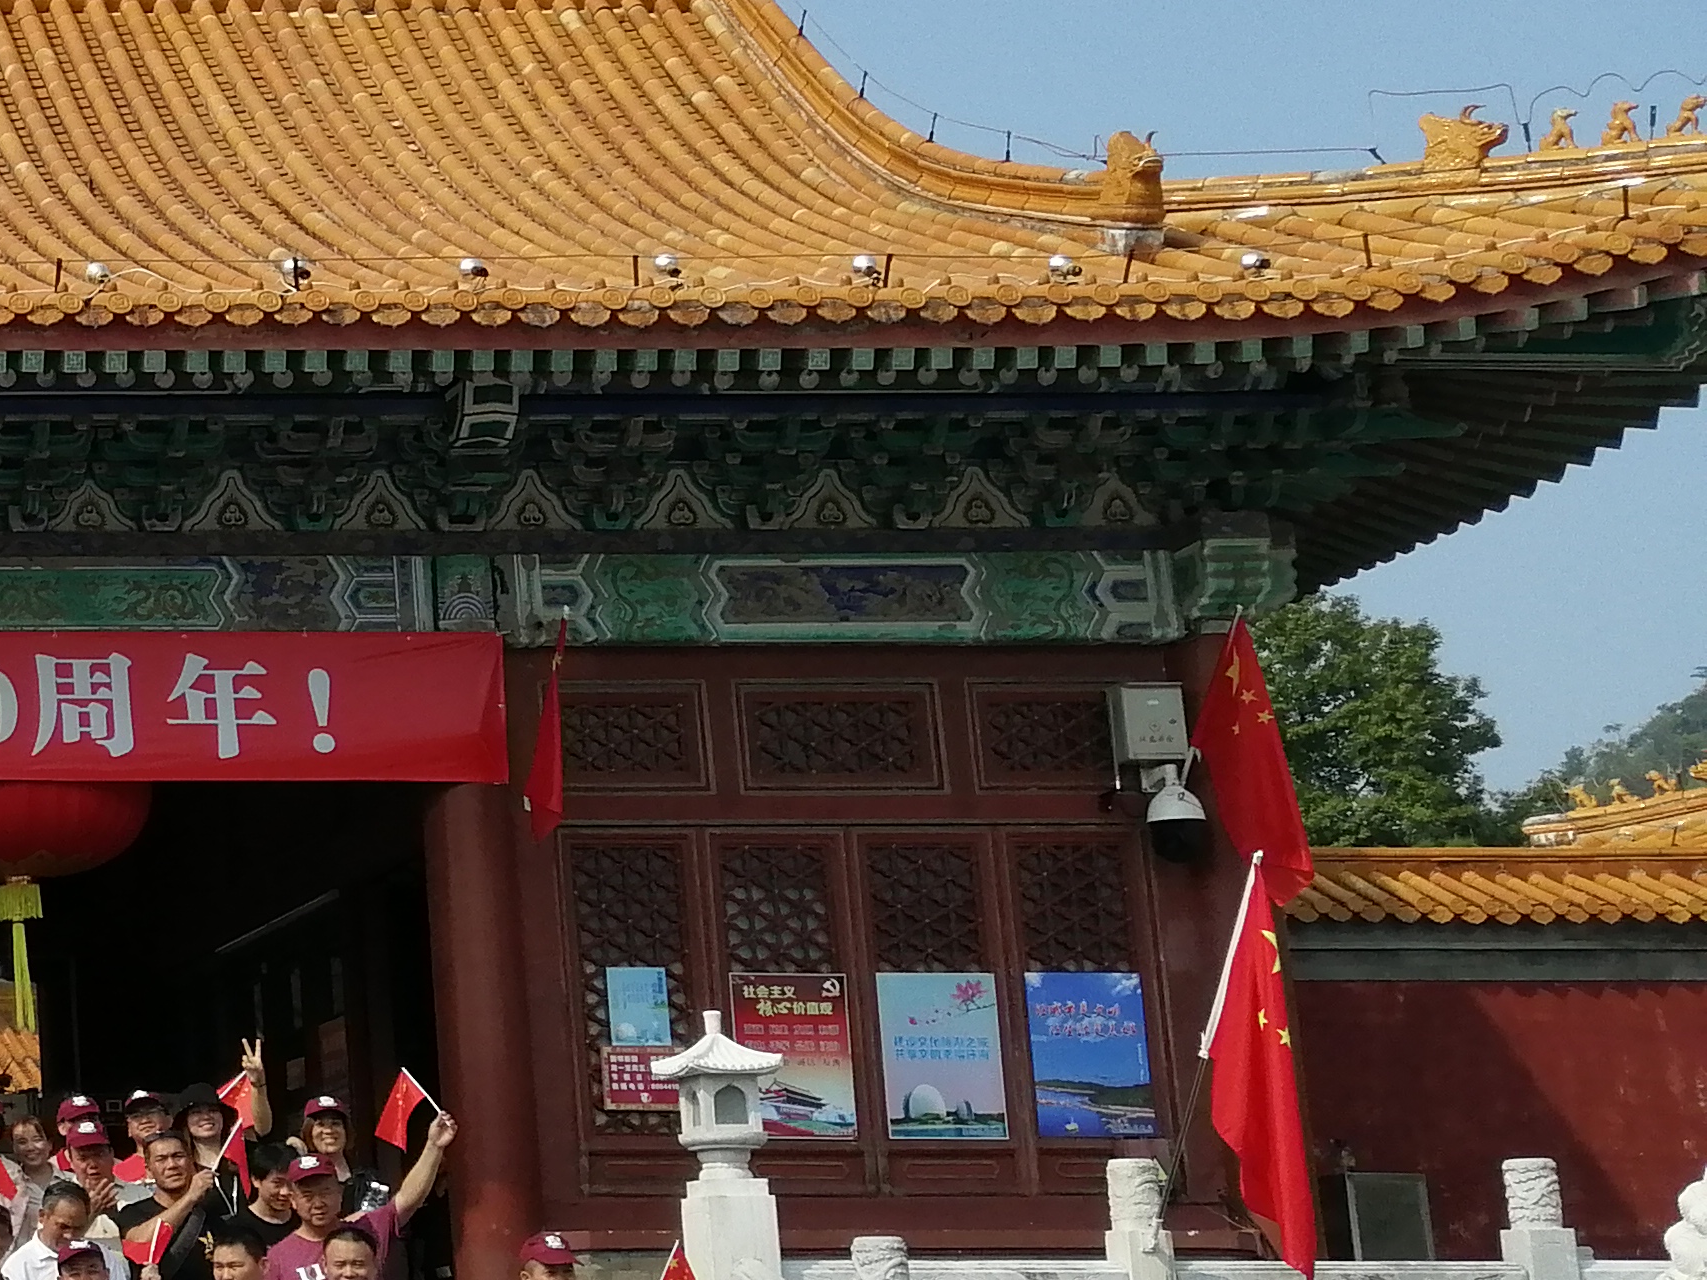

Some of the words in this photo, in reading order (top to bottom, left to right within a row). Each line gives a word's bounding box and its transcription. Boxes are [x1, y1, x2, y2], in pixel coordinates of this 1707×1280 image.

[743, 985, 796, 998] 社会主义
[756, 999, 833, 1017] 核心价值观
